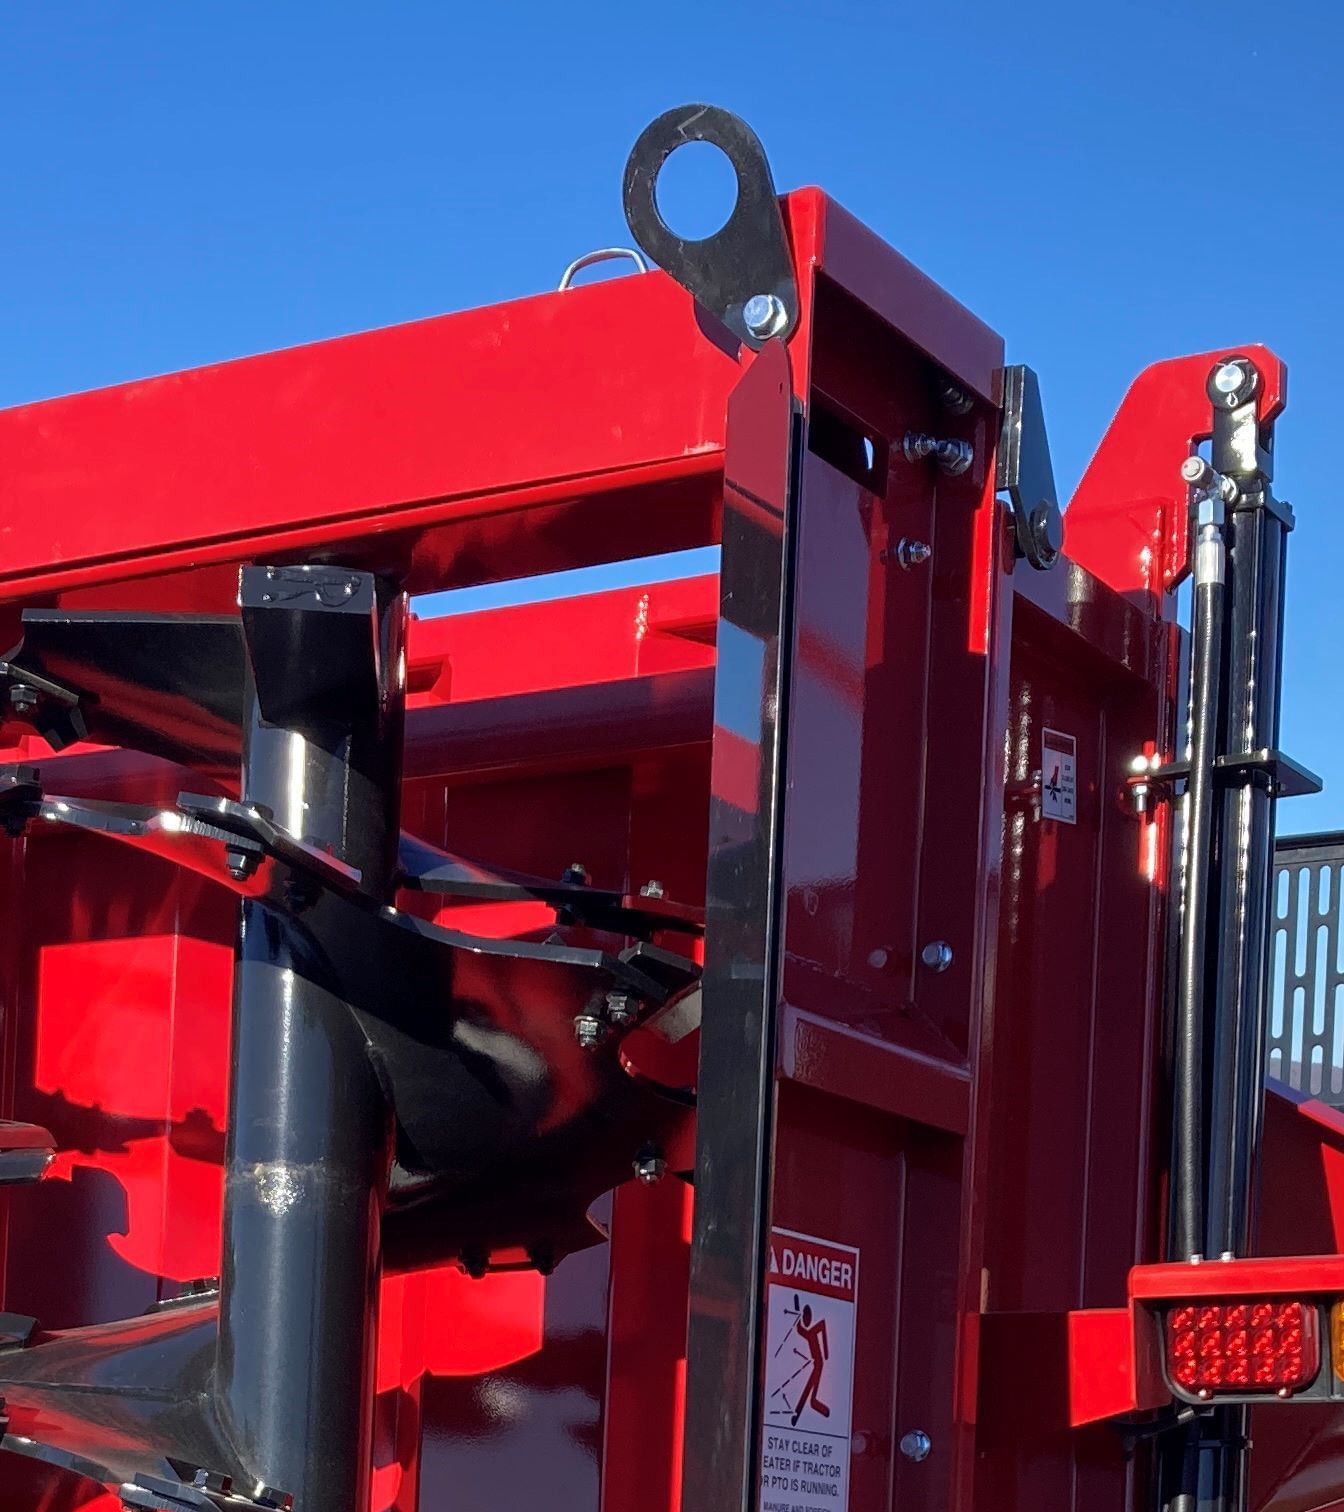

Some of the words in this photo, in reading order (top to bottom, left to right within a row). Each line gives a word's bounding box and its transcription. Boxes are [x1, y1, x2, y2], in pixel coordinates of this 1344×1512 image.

[782, 1249, 852, 1290] DANGER
[768, 1436, 790, 1451] STAY
[792, 1440, 820, 1456] CLEAR
[821, 1445, 833, 1457] OF
[763, 1456, 791, 1471] EATER
[793, 1460, 801, 1473] IF
[802, 1461, 841, 1477] TRACTOR
[772, 1476, 788, 1490] PTO
[791, 1479, 799, 1491] IS
[801, 1480, 840, 1497] RUNNING.
